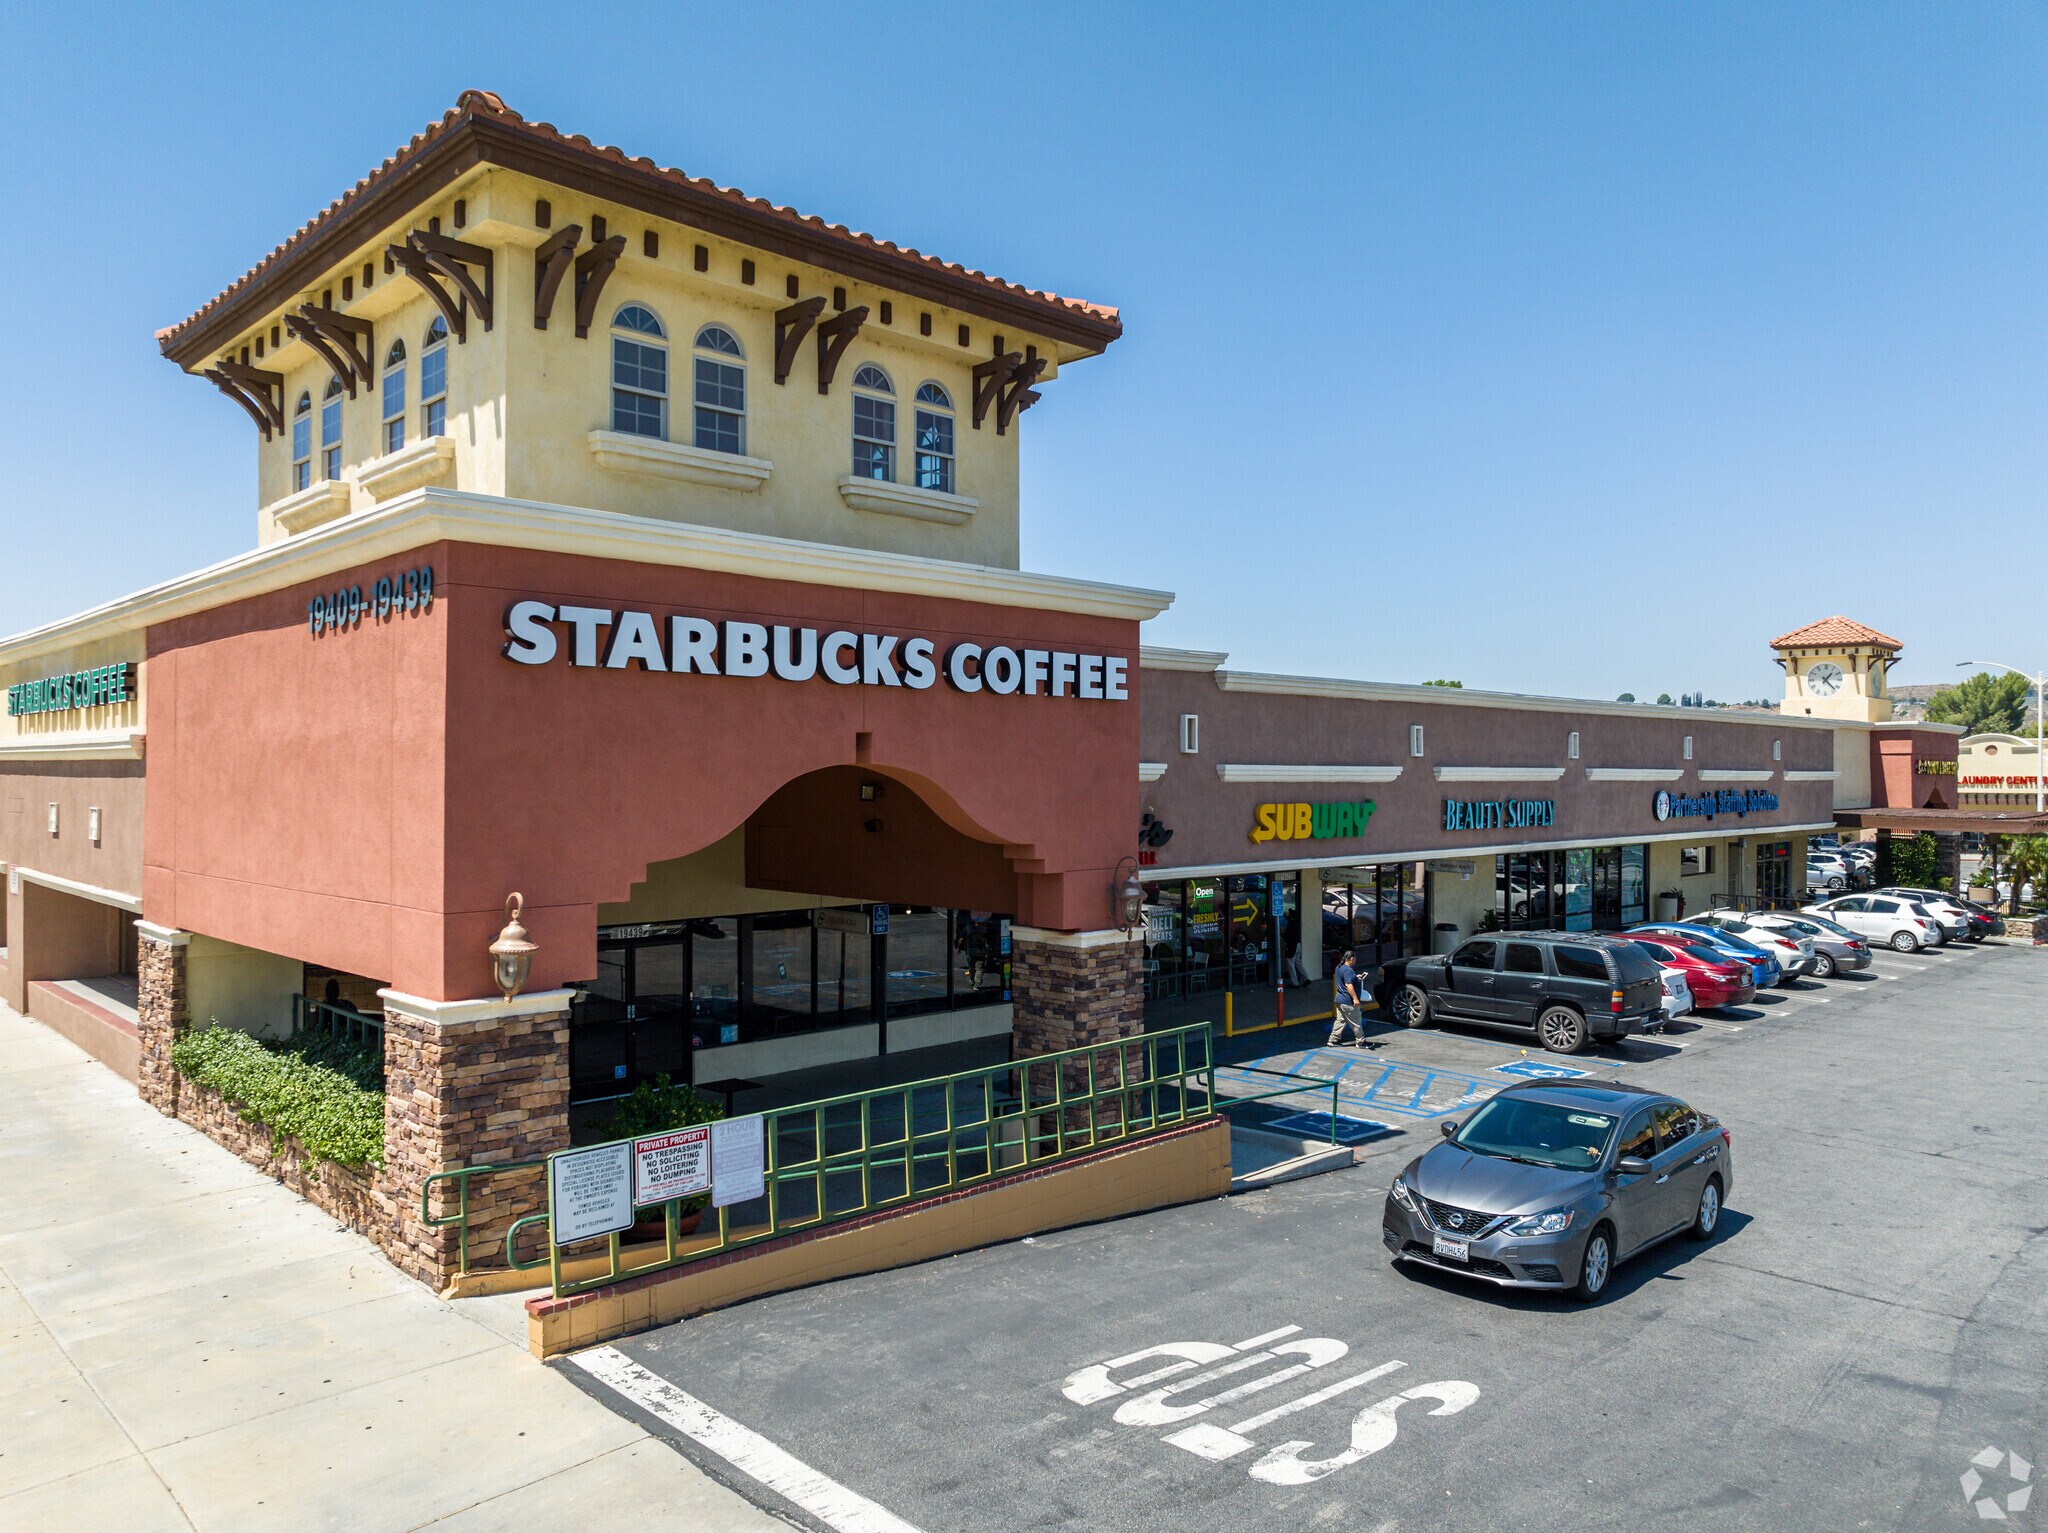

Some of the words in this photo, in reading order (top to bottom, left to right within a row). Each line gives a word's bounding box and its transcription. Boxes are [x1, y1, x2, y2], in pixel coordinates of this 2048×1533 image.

[306, 564, 433, 635] 19409-19439
[505, 600, 936, 690] STARBUCKS
[945, 643, 1129, 700] COFFEE
[8, 673, 72, 716] STARBUCKS
[73, 662, 128, 709] COFFEE
[1249, 800, 1377, 845] SUBWAY
[1446, 799, 1504, 830] BEAUTY
[1508, 799, 1556, 828] SUPPLY
[1195, 887, 1214, 897] Open
[1199, 903, 1213, 912] NOW
[1151, 916, 1173, 931] DELI
[1193, 912, 1219, 924] FRESHLY
[619, 928, 643, 938] 19439
[1151, 931, 1173, 942] MEATS
[719, 1127, 725, 1136] 2
[727, 1120, 755, 1135] HOUR
[639, 1139, 669, 1152] PRIVATE
[669, 1130, 706, 1145] PROPERTY
[642, 1153, 653, 1161] NO
[655, 1142, 703, 1158] TRESPASSING
[646, 1160, 657, 1168] NO
[659, 1151, 700, 1165] SOLICITING
[648, 1167, 659, 1176] NO
[660, 1159, 699, 1173] LOITERING
[650, 1175, 661, 1183] NO
[663, 1167, 697, 1180] DUMPING
[1062, 1325, 1480, 1486] STOP
